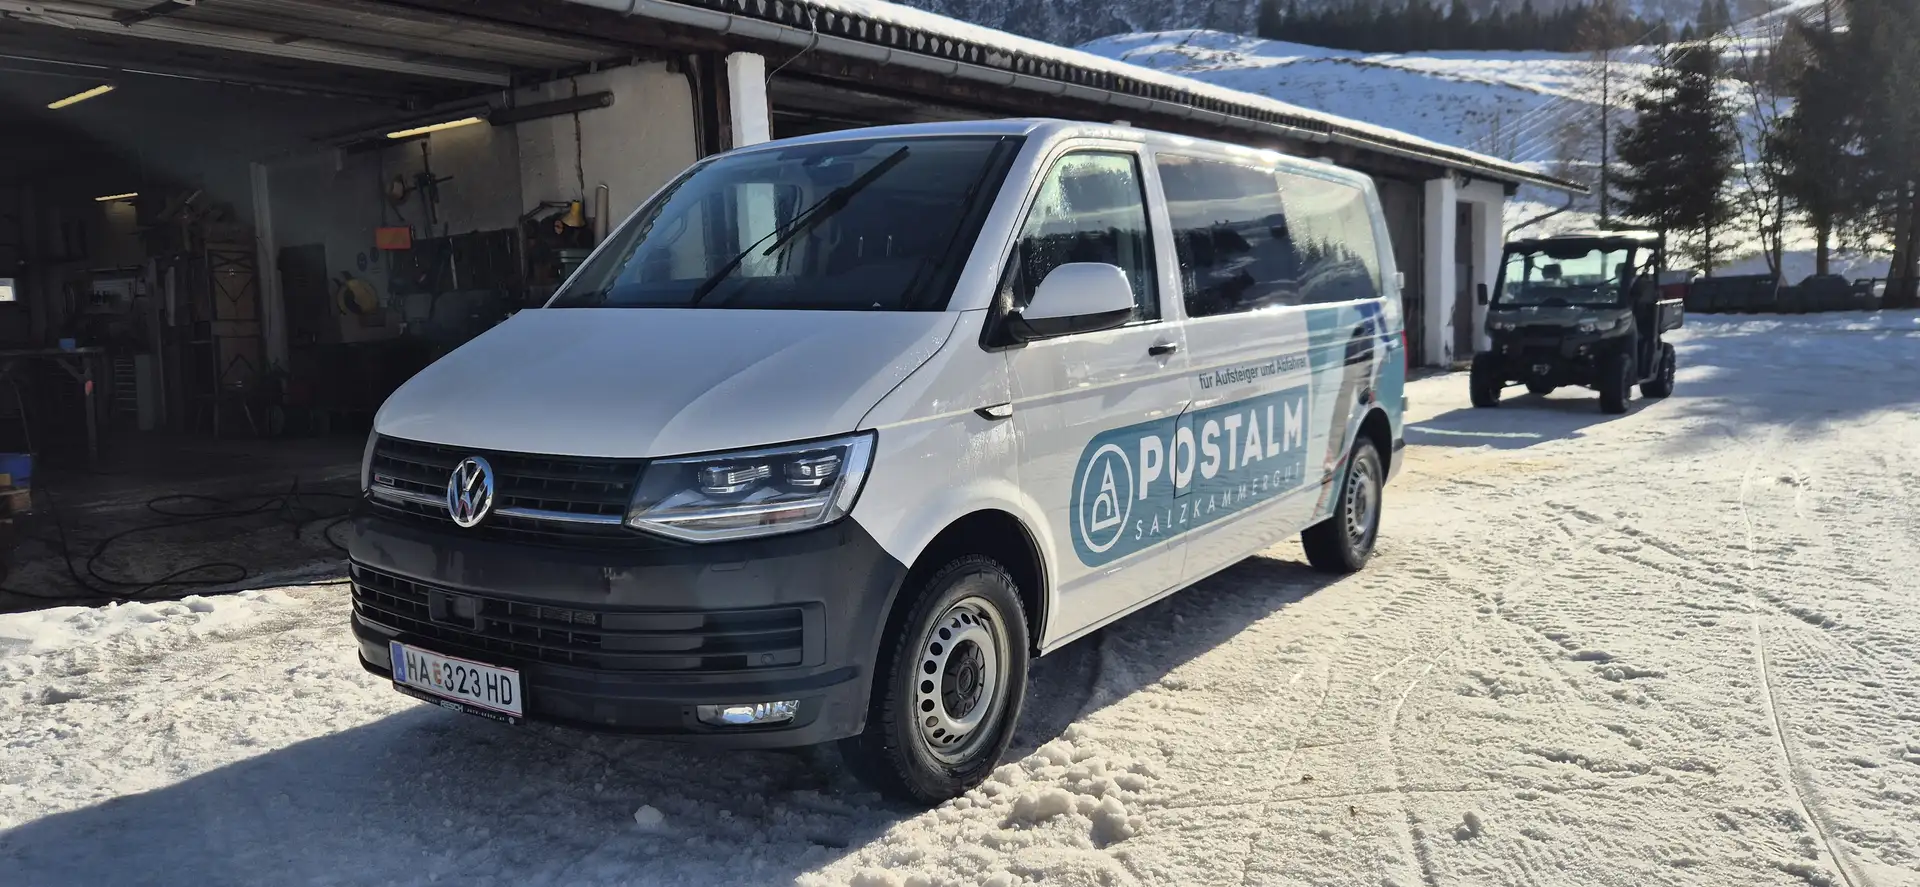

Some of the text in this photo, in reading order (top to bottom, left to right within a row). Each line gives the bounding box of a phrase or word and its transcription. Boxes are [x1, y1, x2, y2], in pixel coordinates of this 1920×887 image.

[1199, 356, 1307, 390] für Aufsteiger und Abfahrer
[1138, 397, 1304, 500] POSTALM
[1135, 462, 1301, 541] SALZKAMMERGUT
[406, 651, 431, 686] HA
[443, 662, 481, 698] 323
[486, 671, 513, 705] HD
